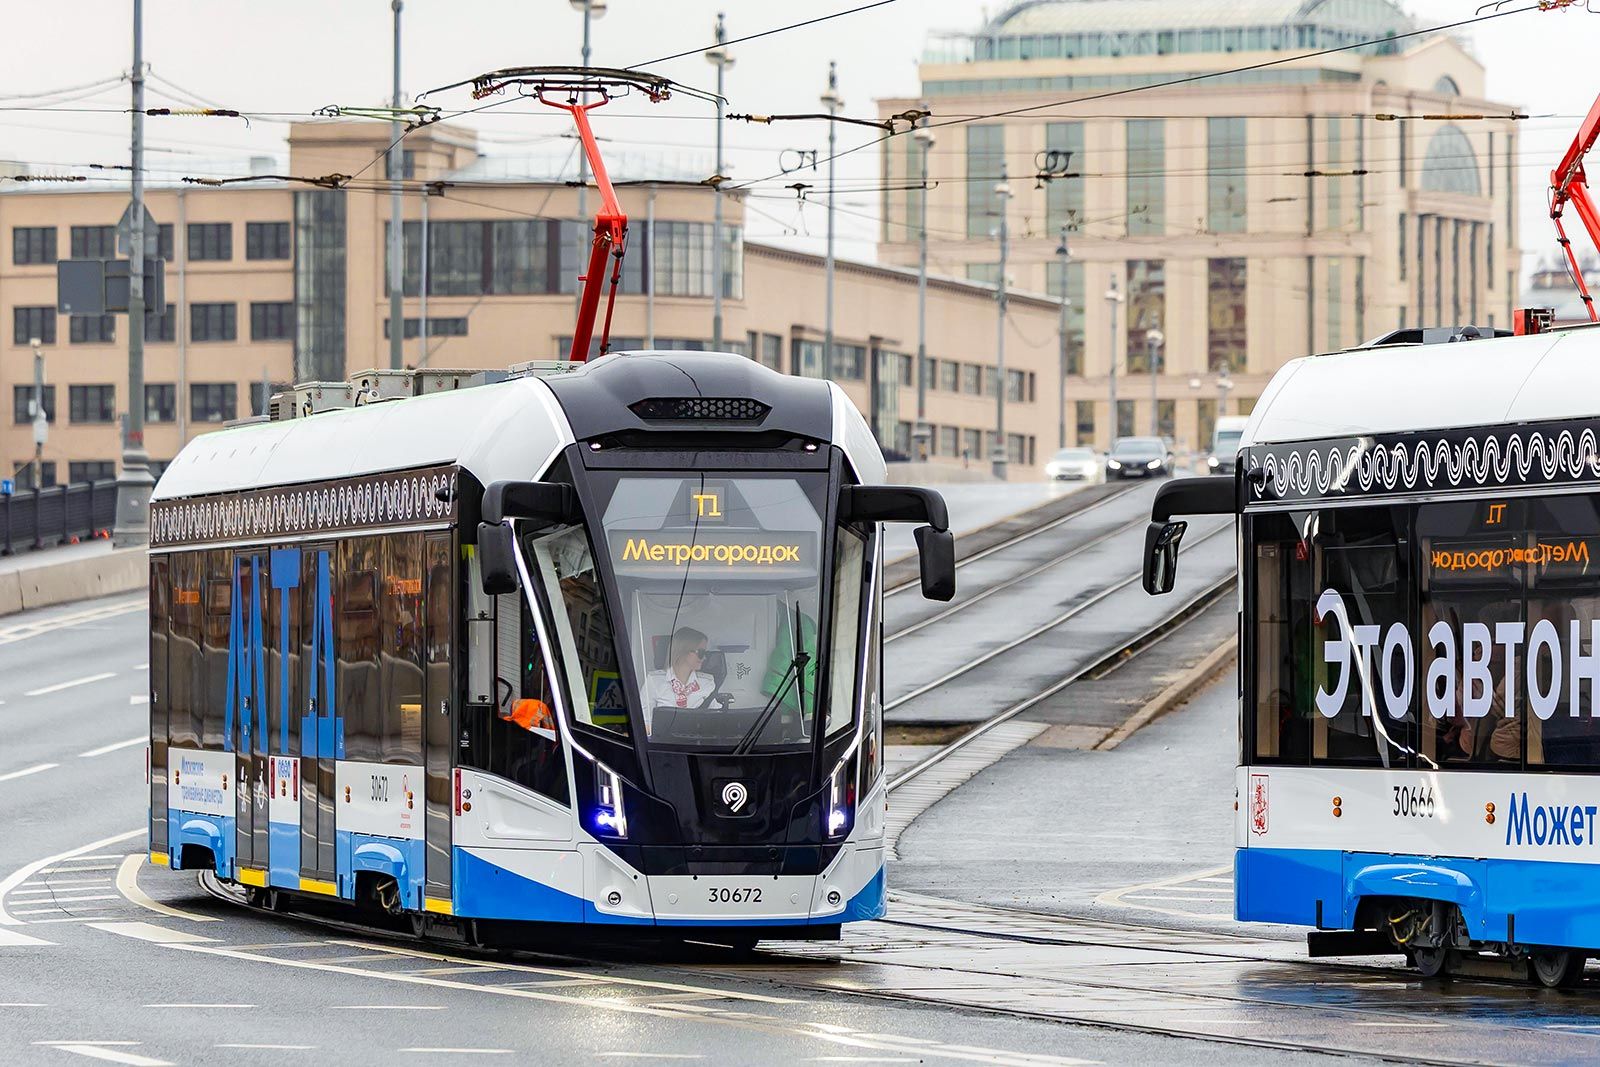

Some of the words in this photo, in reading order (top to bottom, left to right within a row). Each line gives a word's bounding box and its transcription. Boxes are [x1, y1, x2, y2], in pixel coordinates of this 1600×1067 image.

[693, 494, 721, 517] Т1
[623, 538, 800, 566] Метрогородок
[1315, 588, 1415, 719] Это
[1427, 619, 1600, 720] автон
[371, 775, 388, 802] 30672
[1393, 786, 1435, 818] 30666
[1505, 792, 1598, 846] Может
[708, 887, 762, 903] 30672
